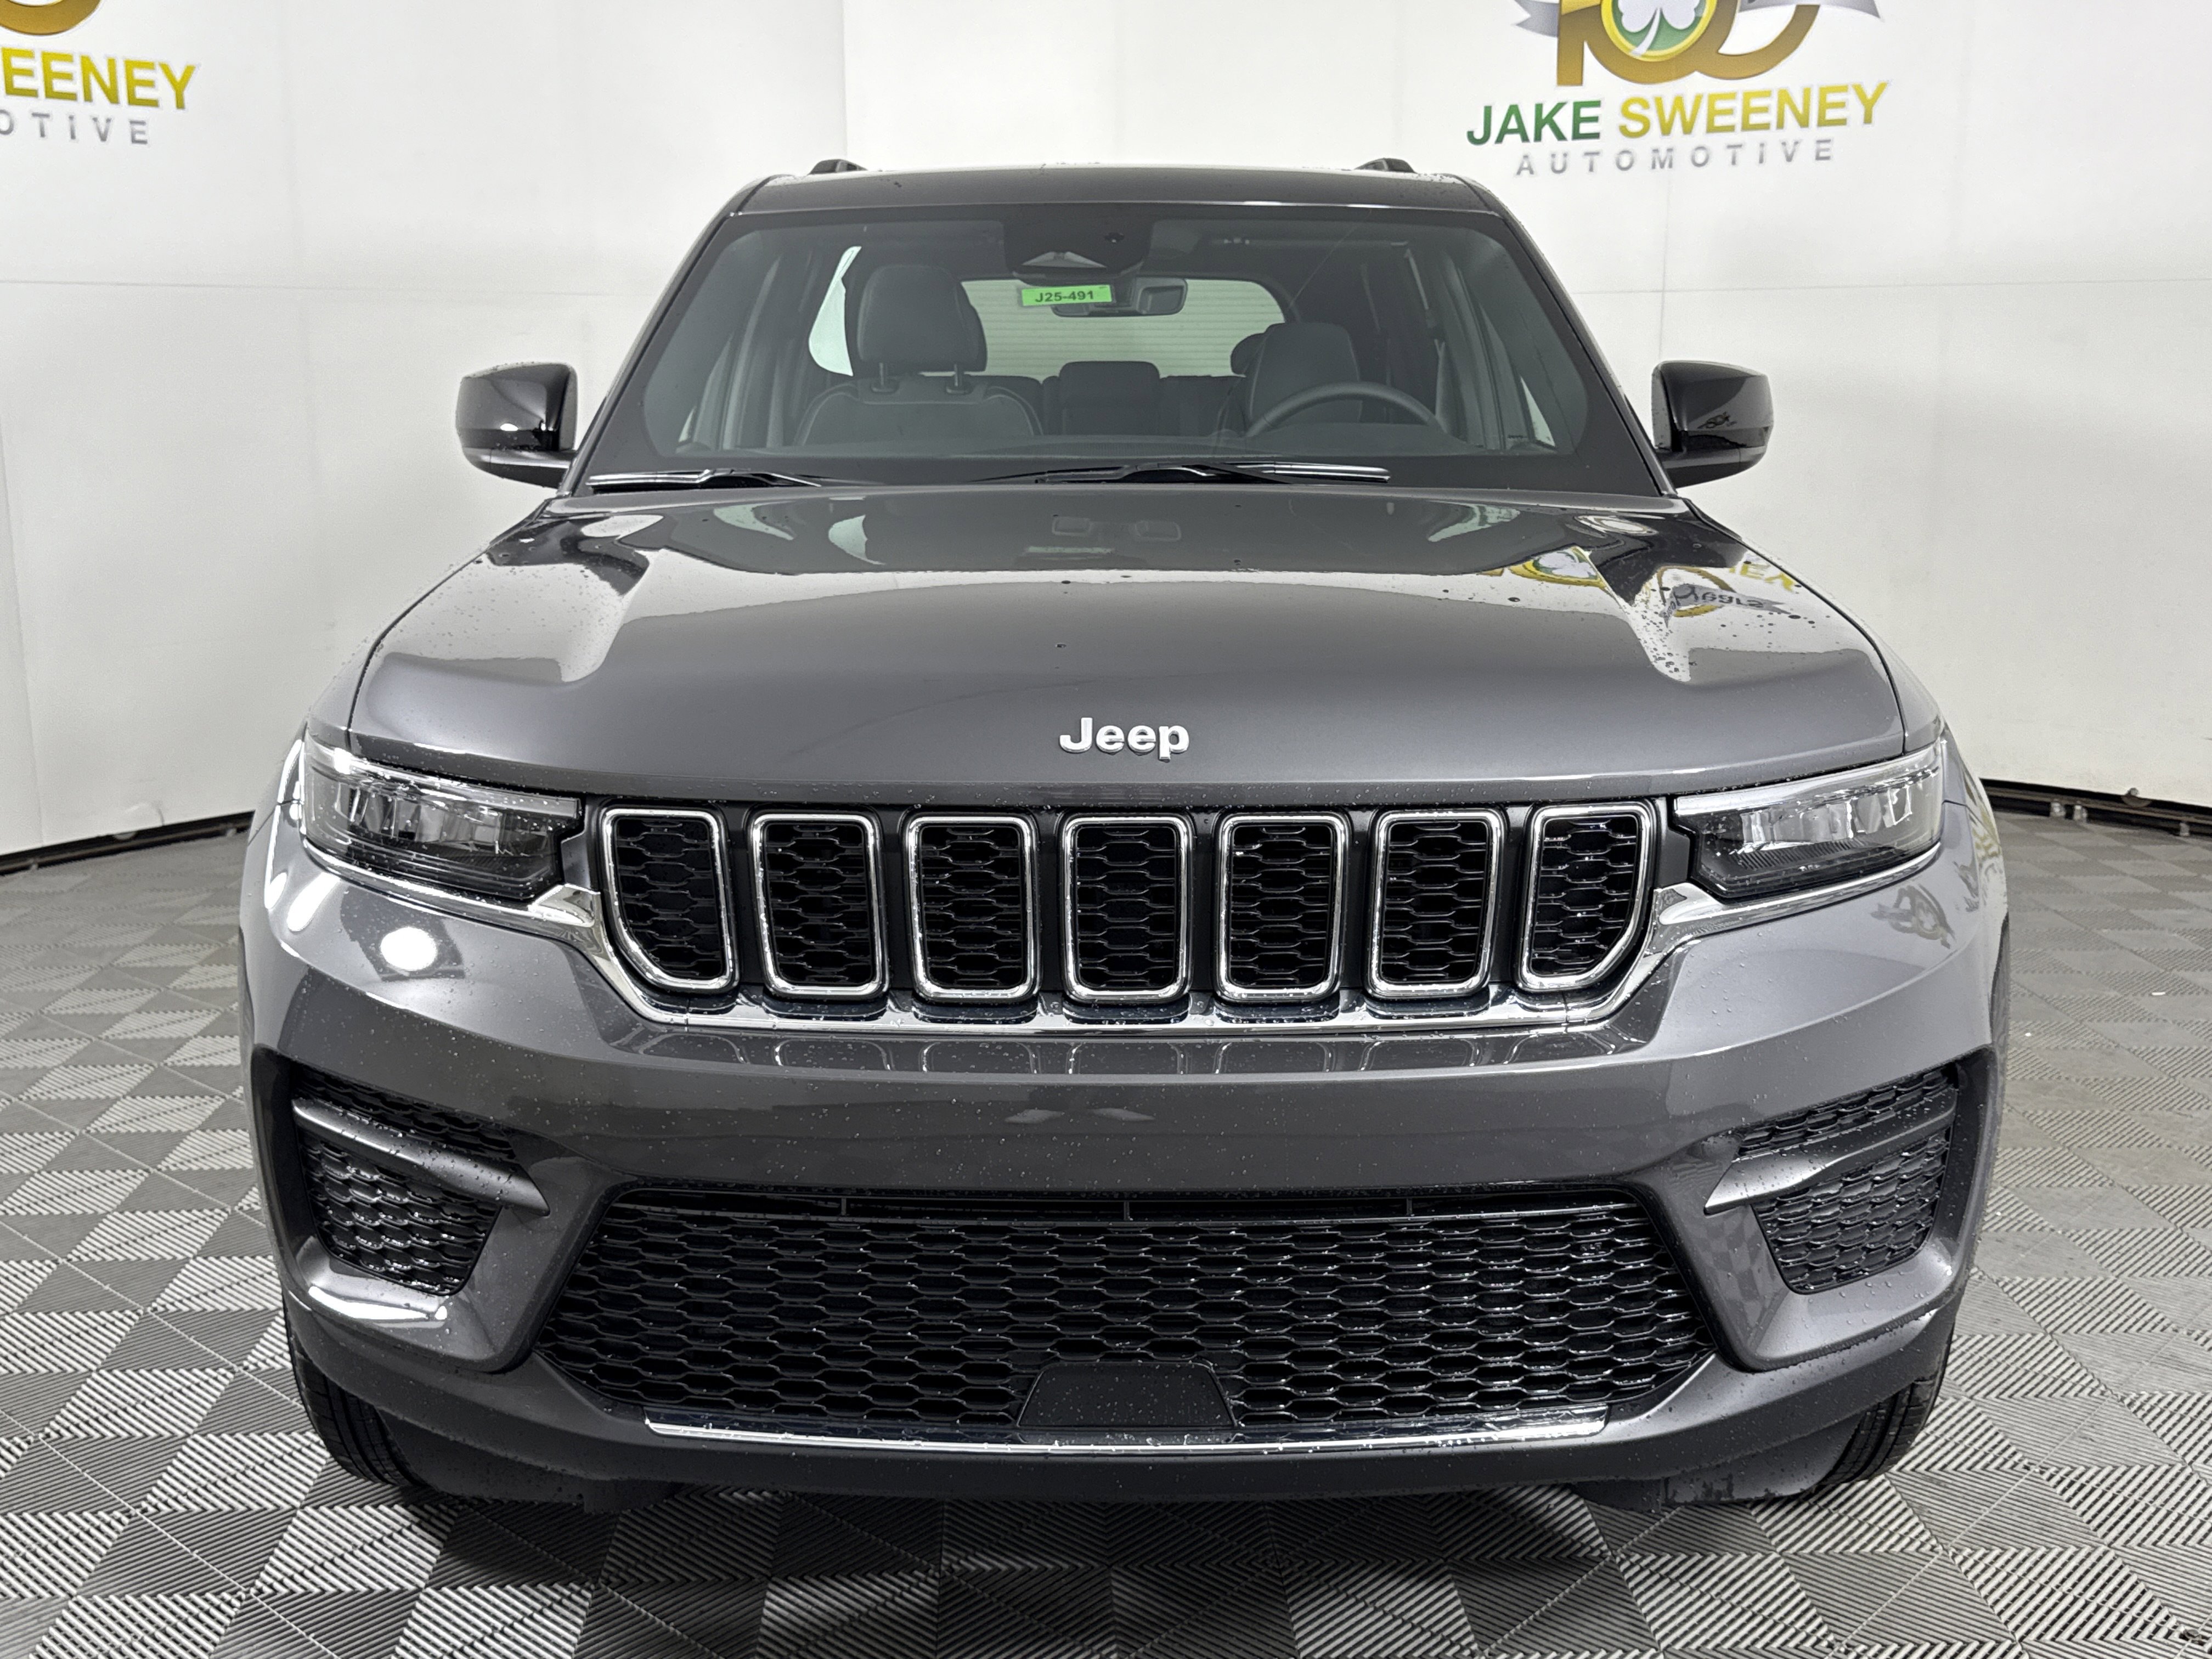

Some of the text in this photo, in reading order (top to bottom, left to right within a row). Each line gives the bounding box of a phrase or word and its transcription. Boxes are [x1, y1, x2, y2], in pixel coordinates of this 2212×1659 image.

[1467, 82, 1888, 145] JAKE SWEENEY
[1516, 139, 1833, 176] AUTOMOTIVE
[1035, 290, 1094, 303] J25-491
[1059, 717, 1189, 760] Jeep
